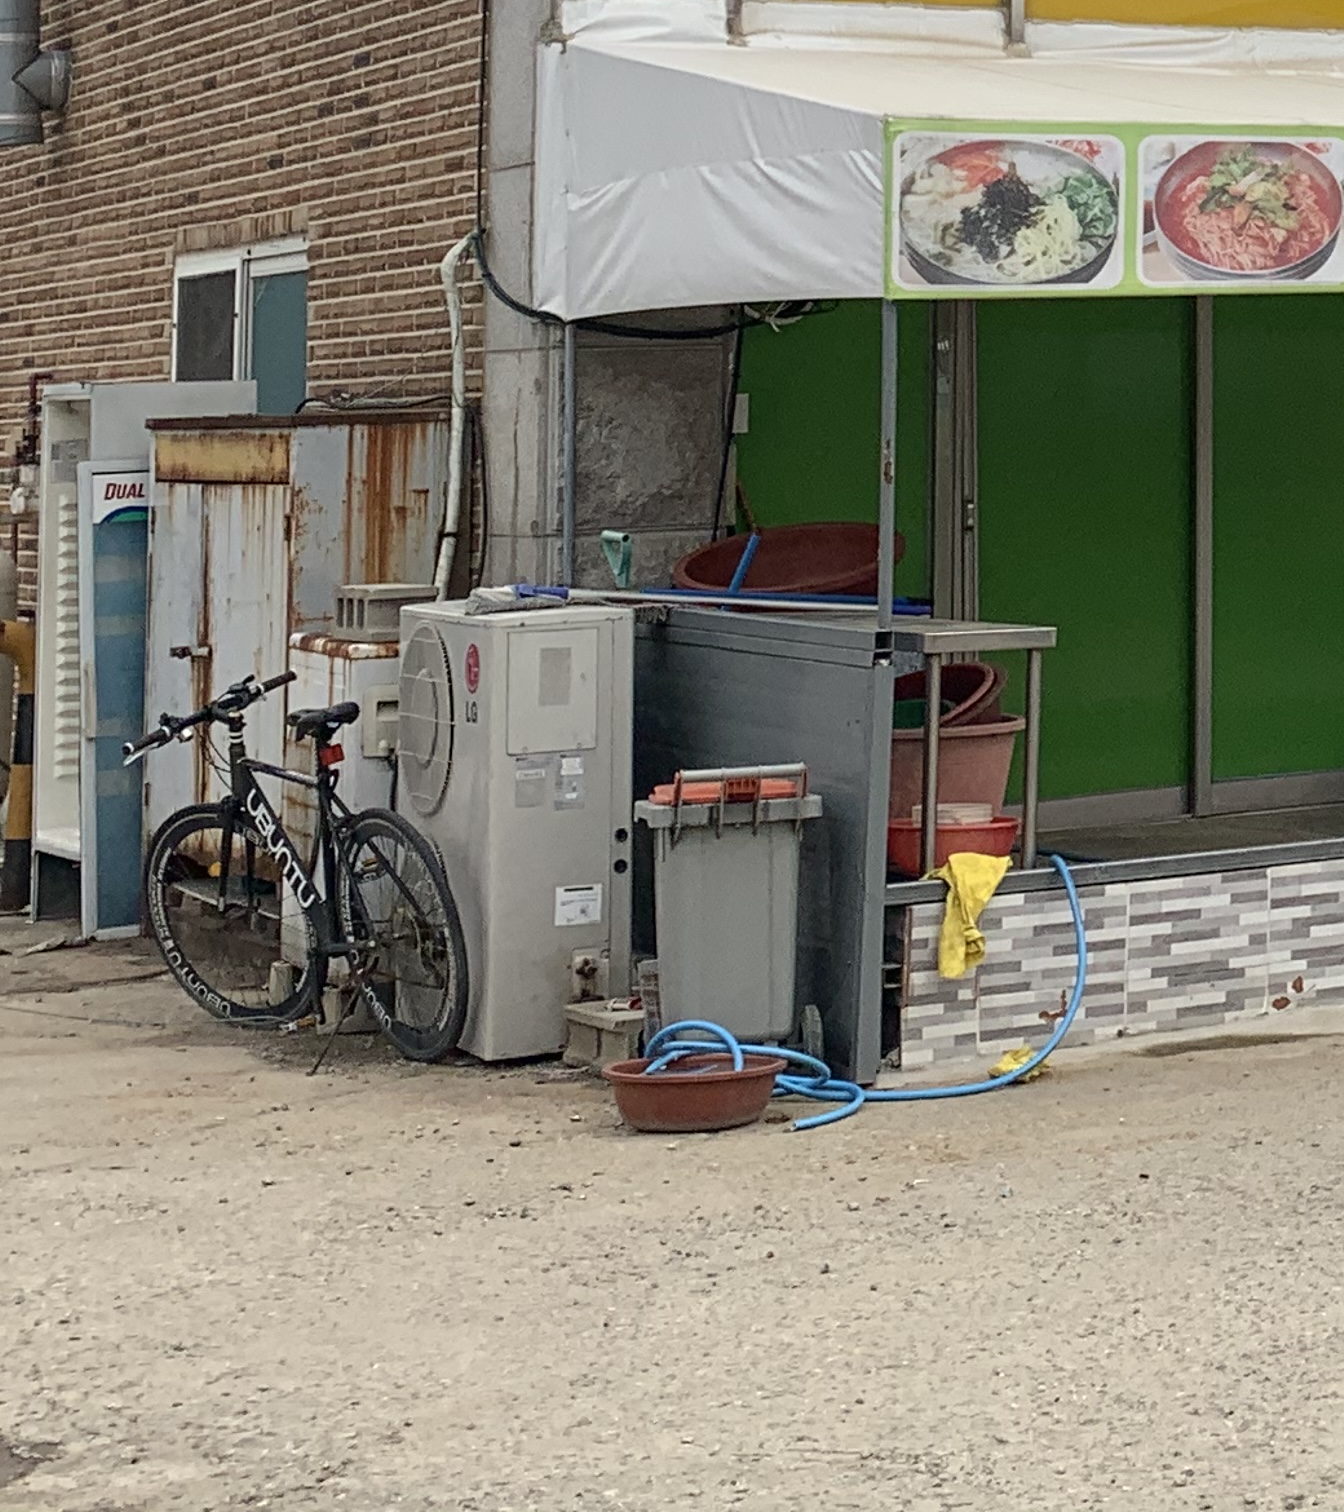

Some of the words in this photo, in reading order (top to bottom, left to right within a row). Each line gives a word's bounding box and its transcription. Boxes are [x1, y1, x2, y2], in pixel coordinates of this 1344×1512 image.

[104, 482, 146, 501] DUAL
[465, 700, 478, 724] LG
[247, 788, 315, 909] UBUNTU
